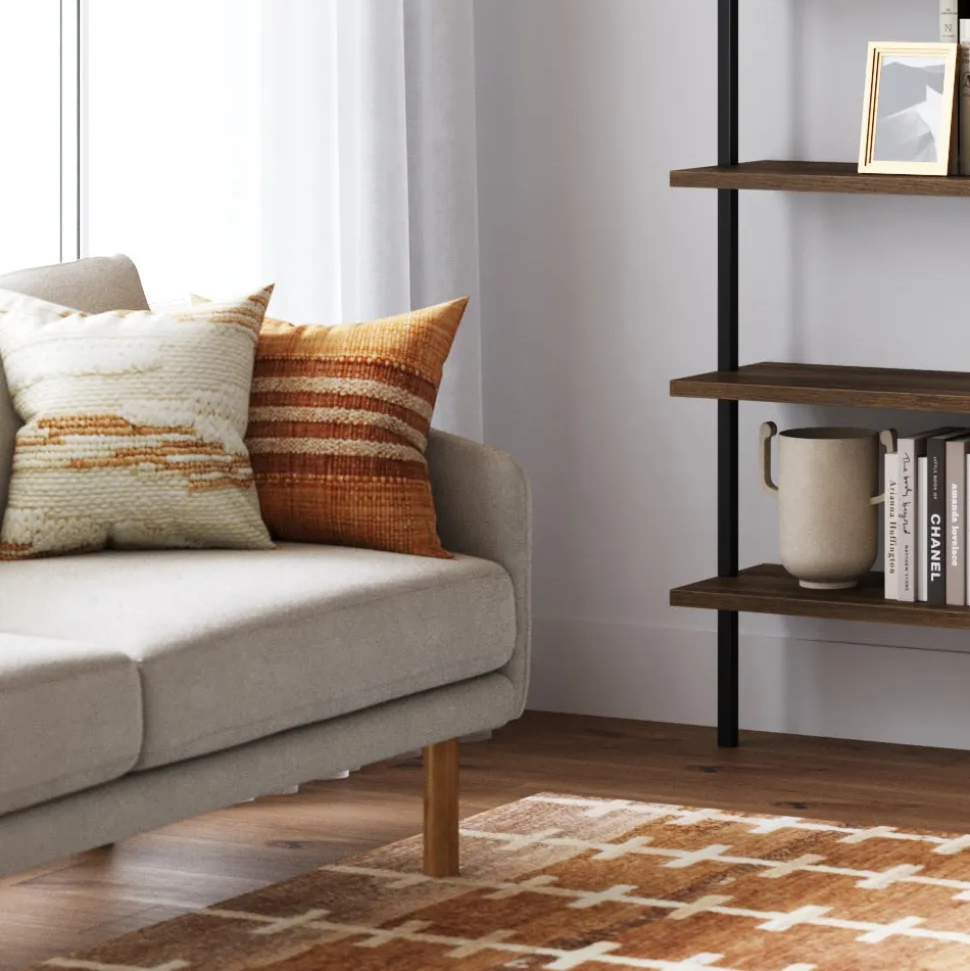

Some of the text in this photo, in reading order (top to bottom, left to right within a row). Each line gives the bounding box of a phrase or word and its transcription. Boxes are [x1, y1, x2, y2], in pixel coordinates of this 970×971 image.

[902, 451, 911, 473] The
[887, 480, 897, 574] Arianna Huffington
[930, 513, 941, 582] CHANEL
[951, 483, 960, 567] amanda lovelace
